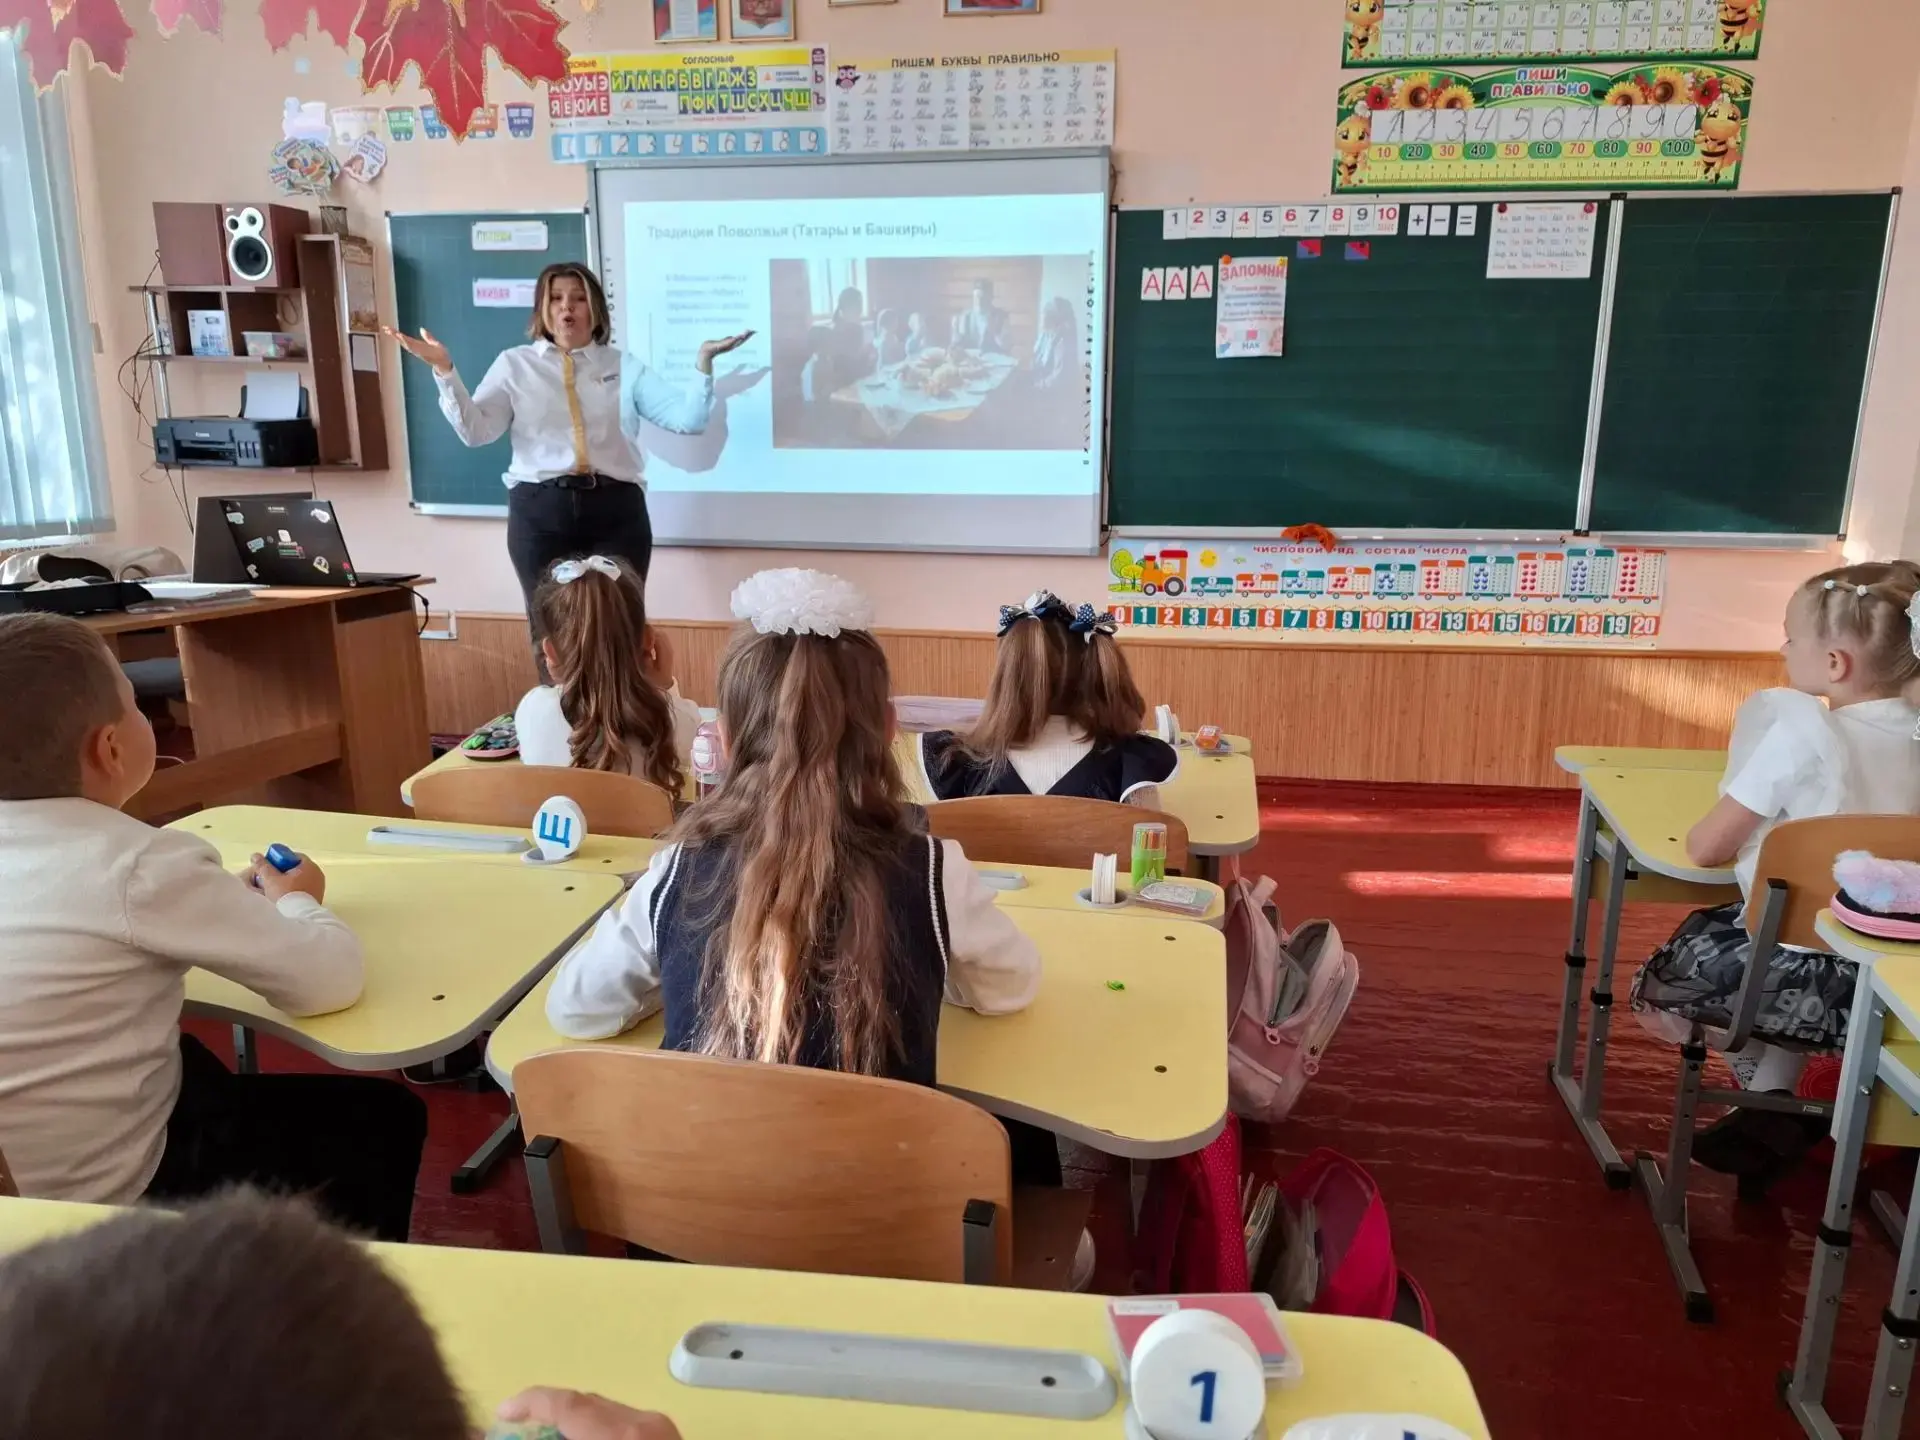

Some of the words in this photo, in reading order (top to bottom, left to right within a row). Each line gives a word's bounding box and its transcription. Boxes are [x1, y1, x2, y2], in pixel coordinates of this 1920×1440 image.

[682, 54, 735, 65] согласные
[891, 57, 935, 68] ПИШЕМ
[941, 55, 982, 66] БУКВЫ
[988, 52, 1060, 65] ПРАВИЛЬНО
[1516, 67, 1567, 80] ПИШИ
[1492, 82, 1590, 97] ПРАВИЛЬНО
[1474, 107, 1496, 141] 4
[1509, 107, 1531, 140] 5
[1542, 106, 1565, 140] 6
[1607, 104, 1631, 139] 8
[1641, 104, 1664, 138] 9
[1377, 147, 1391, 158] 10
[1407, 144, 1423, 158] 20
[1439, 144, 1455, 157] 30
[1470, 143, 1486, 156] 40
[1504, 144, 1520, 156] 50
[1537, 142, 1553, 155] 60
[1570, 142, 1586, 154] 70
[1602, 142, 1618, 154] 80
[1636, 142, 1652, 154] 90
[1667, 141, 1690, 153] 100
[1172, 212, 1179, 225] 1
[1193, 210, 1204, 224] 2
[1215, 210, 1226, 223] 3
[1239, 211, 1250, 224] 4
[1262, 210, 1273, 223] 5
[1285, 208, 1297, 222] 6
[1308, 209, 1320, 223] 7
[1332, 208, 1344, 221] 8
[1357, 207, 1369, 221] 9
[1377, 206, 1398, 221] 10
[647, 225, 714, 240] Традиции
[717, 224, 789, 238] Поволжья
[792, 224, 848, 240] (Татары
[852, 226, 862, 236] и
[865, 221, 937, 238] Башкиры)
[1143, 272, 1161, 295] А
[1167, 271, 1185, 294] А
[1192, 271, 1211, 292] А
[1364, 547, 1416, 555] СОСТАВ
[1423, 547, 1468, 555] ЧИСЛА
[1115, 607, 1125, 623] 0
[1140, 607, 1148, 623] 1
[1163, 608, 1174, 624] 2
[1189, 608, 1199, 625] 3
[1213, 609, 1224, 625] 4
[1239, 609, 1250, 626] 5
[1264, 609, 1275, 626] 6
[1290, 610, 1301, 627] 7
[1316, 610, 1327, 628] 8
[1342, 611, 1353, 628] 9
[1365, 612, 1383, 628] 10
[1390, 612, 1408, 629] 11
[1418, 612, 1437, 629] 12
[1444, 612, 1463, 630] 13
[1471, 613, 1490, 630] 14
[1497, 613, 1518, 631] 15
[1525, 614, 1545, 632] 16
[1552, 615, 1572, 632] 17
[1579, 615, 1600, 633] 18
[1607, 616, 1627, 634] 19
[1632, 616, 1656, 634] 20
[539, 812, 572, 849] Щ
[1190, 1370, 1217, 1424] 1
